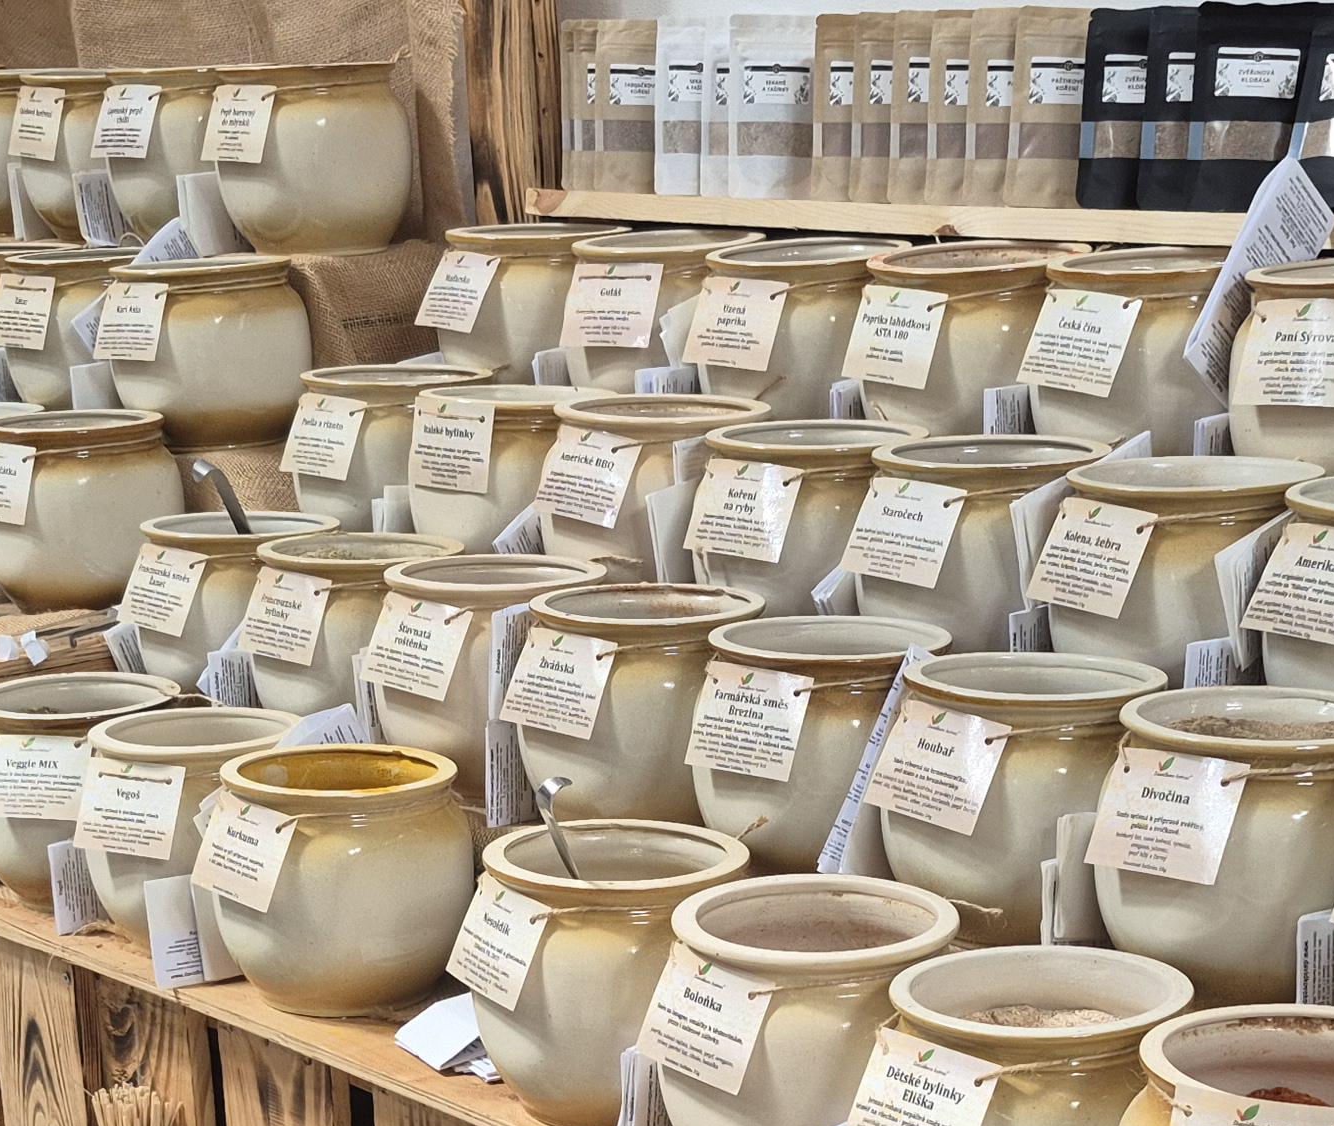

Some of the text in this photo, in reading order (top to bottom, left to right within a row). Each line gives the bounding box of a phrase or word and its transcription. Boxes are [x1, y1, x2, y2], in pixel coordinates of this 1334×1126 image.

[599, 286, 623, 299] Guláš
[721, 303, 747, 316] Uzená
[716, 314, 747, 328] paprika
[861, 312, 932, 332] Paprika lahůdková
[1058, 316, 1102, 335] Česká čína
[872, 327, 910, 342] ASTA 180
[1274, 329, 1298, 343] Paní
[444, 426, 476, 441] bylinky
[560, 451, 616, 472] Americké BBQ
[727, 487, 758, 502] Koření
[723, 501, 757, 515] na ryby
[880, 505, 925, 523] Staročech
[1063, 529, 1123, 553] Kolena, žebra
[263, 604, 291, 621] bylinky
[397, 620, 433, 641] Šťavnatá
[394, 632, 430, 652] roštěnka
[538, 655, 576, 676] Živáňská
[713, 687, 790, 712] Farmářská směs
[727, 703, 765, 722] Brezina
[916, 737, 956, 759] Houbař
[5, 758, 60, 770] Veggie MIX
[116, 787, 142, 801] Vegoš
[1140, 785, 1192, 807] Divočina
[226, 825, 260, 848] Kurkuma
[682, 985, 724, 1013] Boloňka
[886, 1065, 966, 1105] Dětské bylinky
[902, 1088, 935, 1111] Eliška
